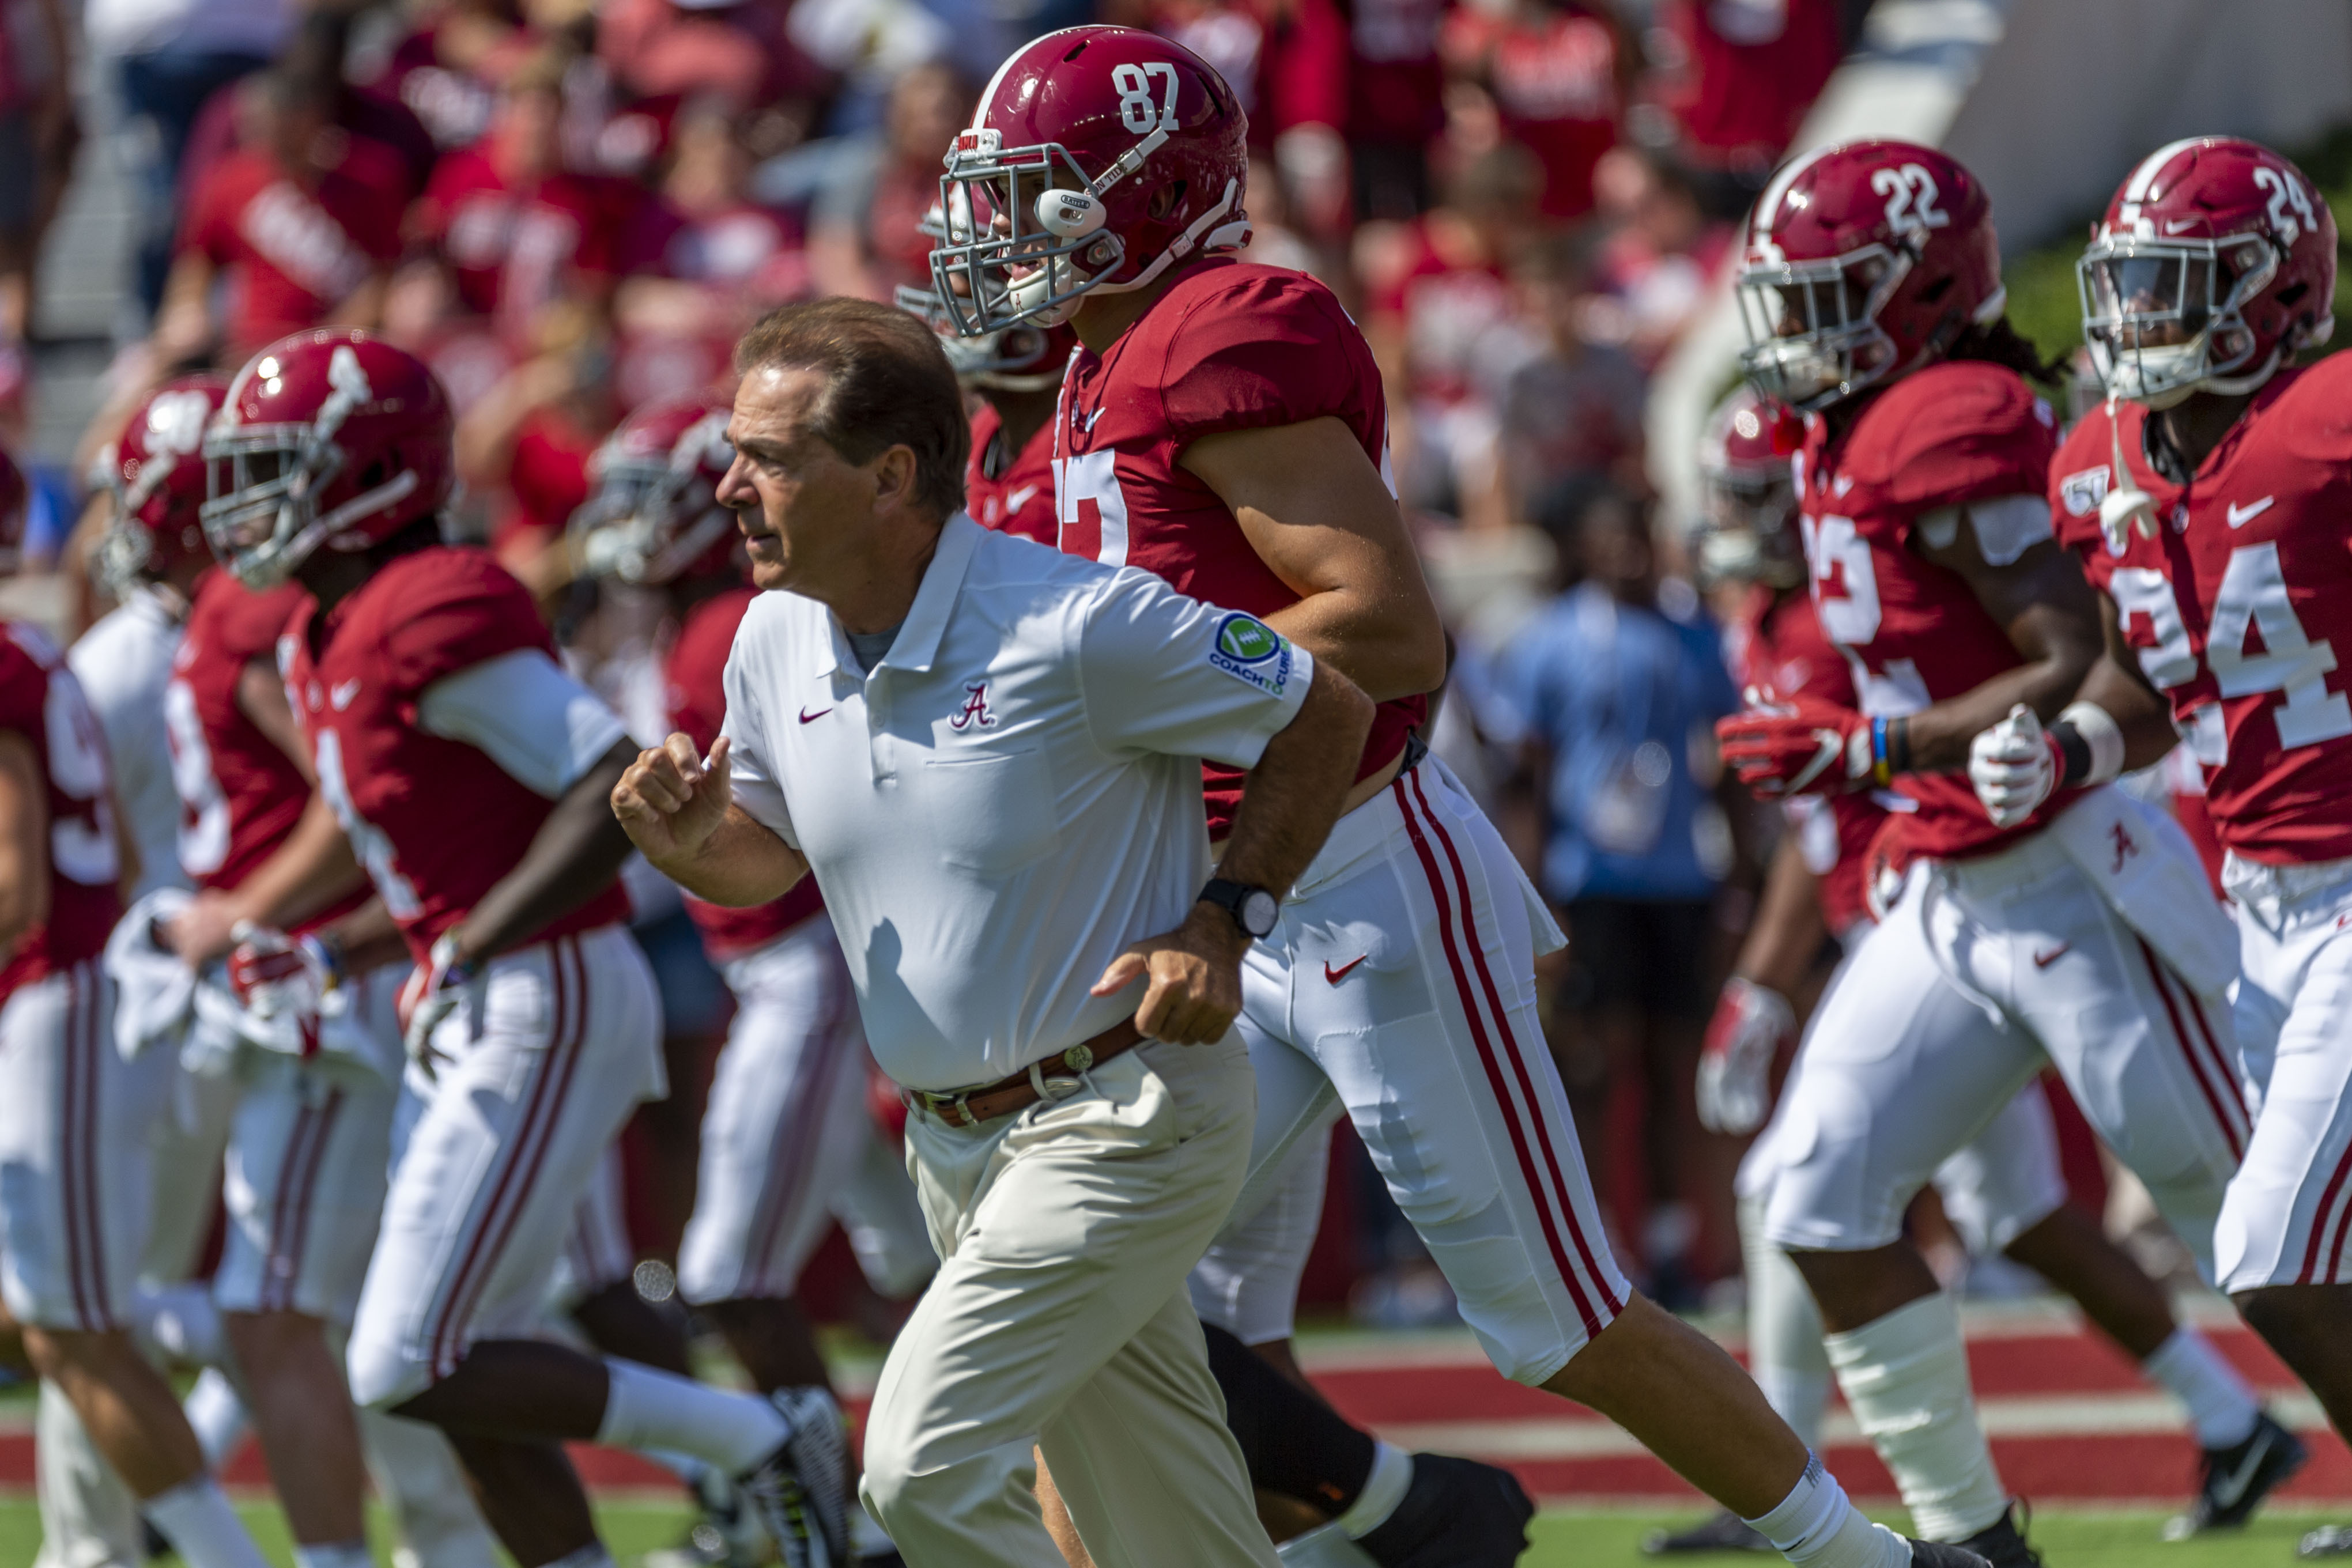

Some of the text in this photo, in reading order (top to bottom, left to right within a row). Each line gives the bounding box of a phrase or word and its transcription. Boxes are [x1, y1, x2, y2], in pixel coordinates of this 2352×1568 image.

[1111, 62, 1180, 134] 87
[1063, 196, 1088, 208] BATTLE
[1870, 163, 1950, 237] 22
[2253, 166, 2318, 232] 24
[950, 683, 992, 729] A
